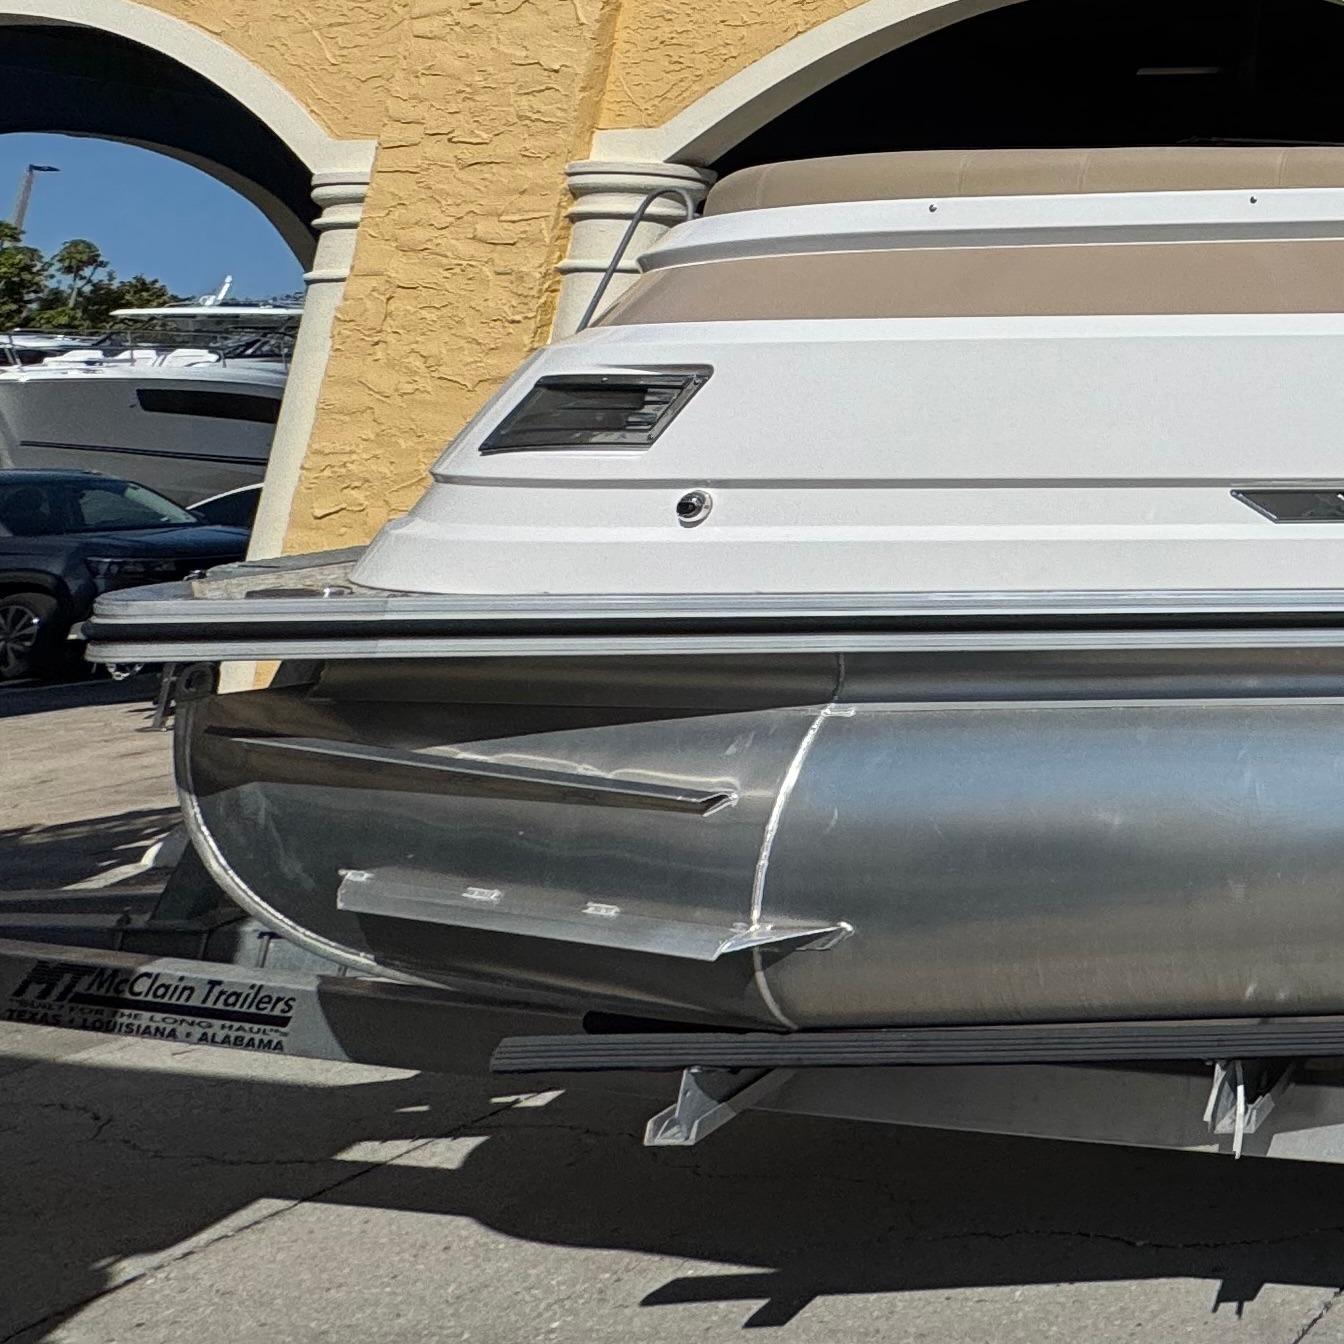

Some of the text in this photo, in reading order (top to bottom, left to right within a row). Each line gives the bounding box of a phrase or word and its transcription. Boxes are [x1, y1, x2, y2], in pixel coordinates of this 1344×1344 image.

[84, 966, 297, 1015] McClain Trailers
[6, 1008, 285, 1052] TEXAS LOUISIANA ALABAMA
[149, 1013, 214, 1030] LONG
